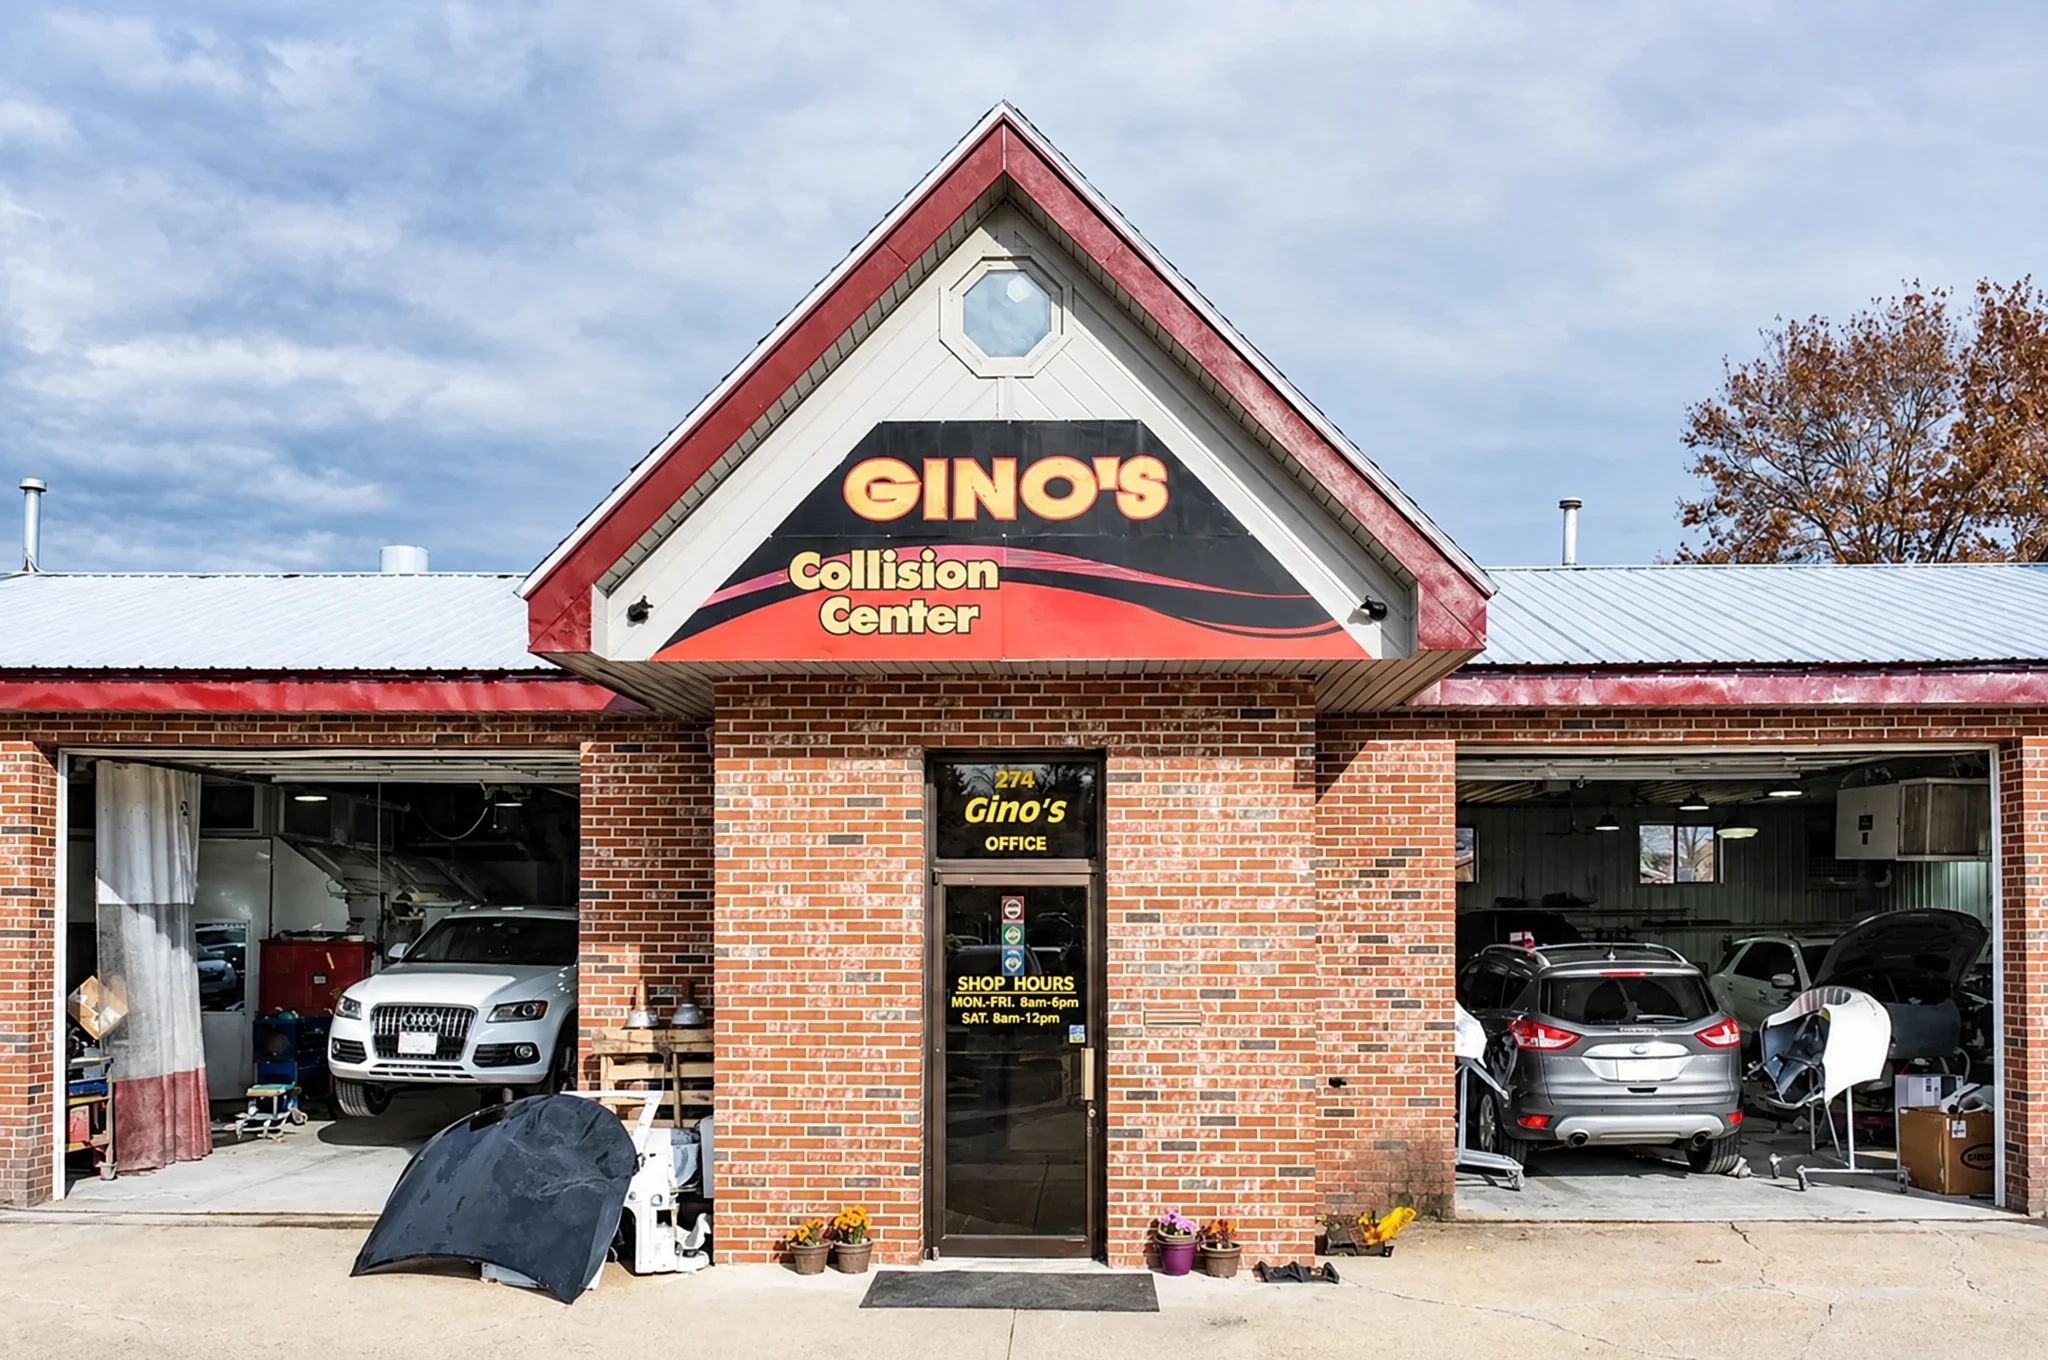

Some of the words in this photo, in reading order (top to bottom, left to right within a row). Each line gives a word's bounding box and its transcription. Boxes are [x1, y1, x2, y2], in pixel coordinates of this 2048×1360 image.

[843, 455, 1169, 521] GINO'S
[788, 546, 1000, 591] Collision
[819, 595, 980, 635] Center
[995, 770, 1035, 788] 274
[964, 794, 1067, 823] Gino's
[985, 836, 1047, 851] OFFICE
[957, 976, 1006, 991] SHOP
[1014, 976, 1075, 991] HOURS
[1020, 997, 1079, 1010] 8am-6pm
[961, 1012, 989, 1024] SAT.
[992, 1012, 1060, 1026] 8am-12pm
